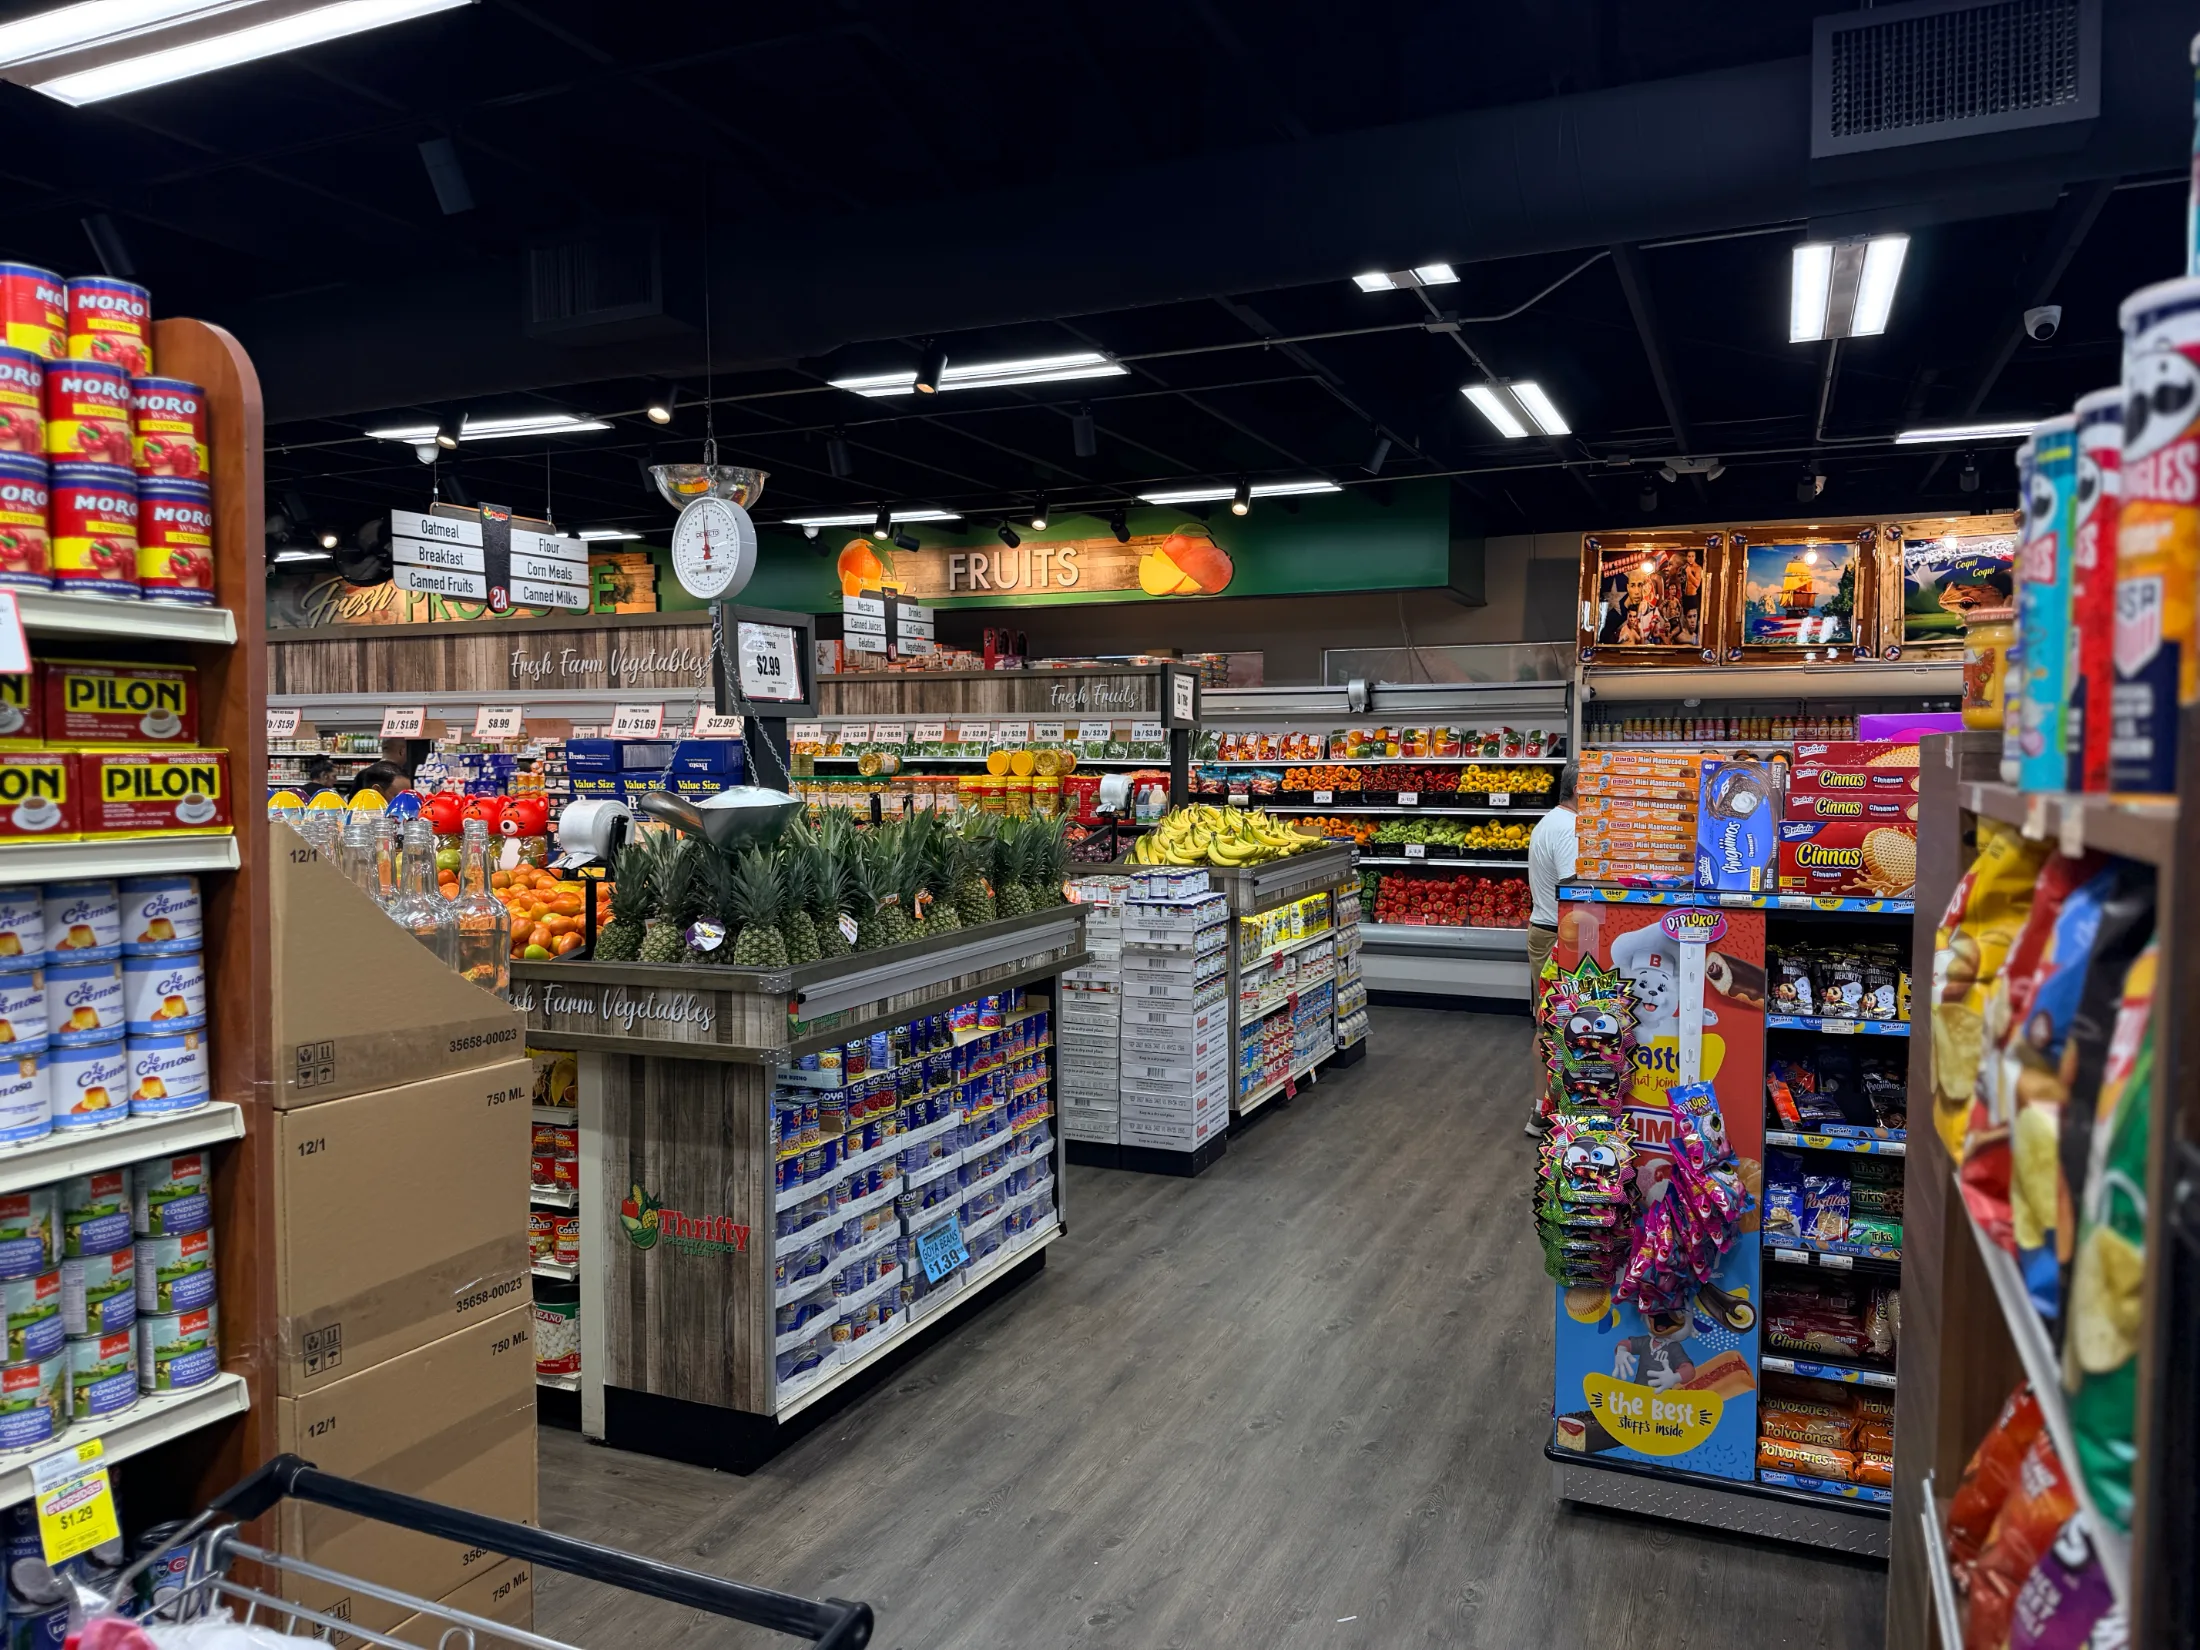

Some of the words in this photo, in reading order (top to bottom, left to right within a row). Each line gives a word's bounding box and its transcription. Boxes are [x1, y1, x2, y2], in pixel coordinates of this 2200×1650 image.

[78, 294, 144, 316] MORO
[0, 363, 42, 388] ORO
[61, 376, 129, 400] MORO
[152, 411, 182, 421] Whole
[148, 420, 186, 433] Peppers
[0, 484, 47, 506] ORO
[75, 494, 138, 517] MORO
[154, 506, 211, 528] MORO
[421, 519, 460, 539] Oatmeal
[538, 538, 560, 554] Flour
[419, 546, 464, 566] Breakfast
[527, 561, 547, 578] Corn
[549, 564, 573, 581] Meals
[949, 546, 1080, 592] FRUITS
[410, 572, 445, 592] Canned
[448, 576, 474, 594] Fruits
[303, 576, 396, 629] Fresh
[493, 588, 508, 611] 2A
[523, 586, 554, 604] Canned
[557, 590, 578, 606] Milks
[857, 601, 875, 612] Nectars
[908, 607, 922, 618] Drinks
[851, 618, 867, 630] Canned
[868, 621, 882, 632] Juices
[905, 624, 913, 634] Cut
[913, 626, 925, 636] Fruits
[905, 641, 926, 653] Vegetables
[511, 650, 554, 681] Fresh
[560, 648, 605, 677] Farm
[610, 647, 706, 684] Vegetables
[756, 655, 781, 677] $2.99
[70, 678, 182, 711] PILON
[1051, 684, 1089, 708] Fresh
[1093, 684, 1138, 708] Fruits
[277, 719, 295, 729] $1.59
[387, 719, 396, 729] Lb
[400, 719, 418, 730] $1.69
[488, 718, 510, 730] $8.99
[617, 718, 629, 730] Lb
[633, 718, 656, 731] $1.69
[706, 717, 735, 728] $12.99
[569, 751, 586, 760] Presto
[689, 762, 708, 771] Presto
[106, 767, 216, 797] PILON
[574, 779, 596, 789] Value
[597, 779, 616, 789] Size
[624, 780, 647, 790] Value
[648, 780, 667, 790] Size
[677, 780, 701, 790] Value
[702, 780, 721, 790] Size
[1650, 780, 1685, 788] Mantecadas
[1820, 770, 1866, 787] Cinnas
[1873, 775, 1904, 784] Cinnamon
[1651, 802, 1687, 810] Mantecadas
[1815, 797, 1862, 816] Cinnas
[1869, 803, 1899, 812] Cinnamon
[1634, 822, 1647, 830] Mini
[1648, 823, 1683, 832] Mantecadas
[1651, 842, 1686, 850] Mantecadas
[1796, 843, 1863, 868] Cinnas
[290, 848, 317, 864] 12/1
[1650, 864, 1685, 872] Mantecadas
[142, 896, 198, 918] Cremosa
[156, 894, 169, 908] La
[1649, 953, 1662, 967] B
[171, 971, 183, 984] La
[79, 981, 94, 994] La
[542, 983, 597, 1016] Farm
[602, 987, 716, 1031] Vegetables
[450, 1028, 517, 1053] 35658-00023
[135, 1053, 196, 1077] Cremosa
[487, 1092, 507, 1107] 750
[509, 1087, 526, 1104] ML
[299, 1138, 326, 1157] 12/1
[1770, 1194, 1790, 1202] Butter
[164, 1199, 209, 1217] CONDENSED
[657, 1209, 751, 1252] Thrifty
[664, 1237, 699, 1249] SPECIALTY
[699, 1240, 736, 1253] PRODUCE
[690, 1248, 715, 1258] MEATS
[922, 1242, 940, 1261] GOYA
[938, 1229, 959, 1249] BEANS
[928, 1248, 961, 1275] $1.39
[456, 1278, 523, 1313] 35658-00023
[491, 1338, 510, 1356] 750
[511, 1331, 529, 1349] ML
[1769, 1331, 1821, 1352] Cinnas
[1608, 1391, 1643, 1416] the
[308, 1416, 337, 1438] 12/1
[1655, 1422, 1684, 1438] inside
[1766, 1421, 1834, 1446] Polvorones
[1761, 1441, 1829, 1465] Polvorones
[59, 1505, 93, 1530] $1.29
[492, 1580, 512, 1602] 750
[512, 1572, 529, 1592] ML
